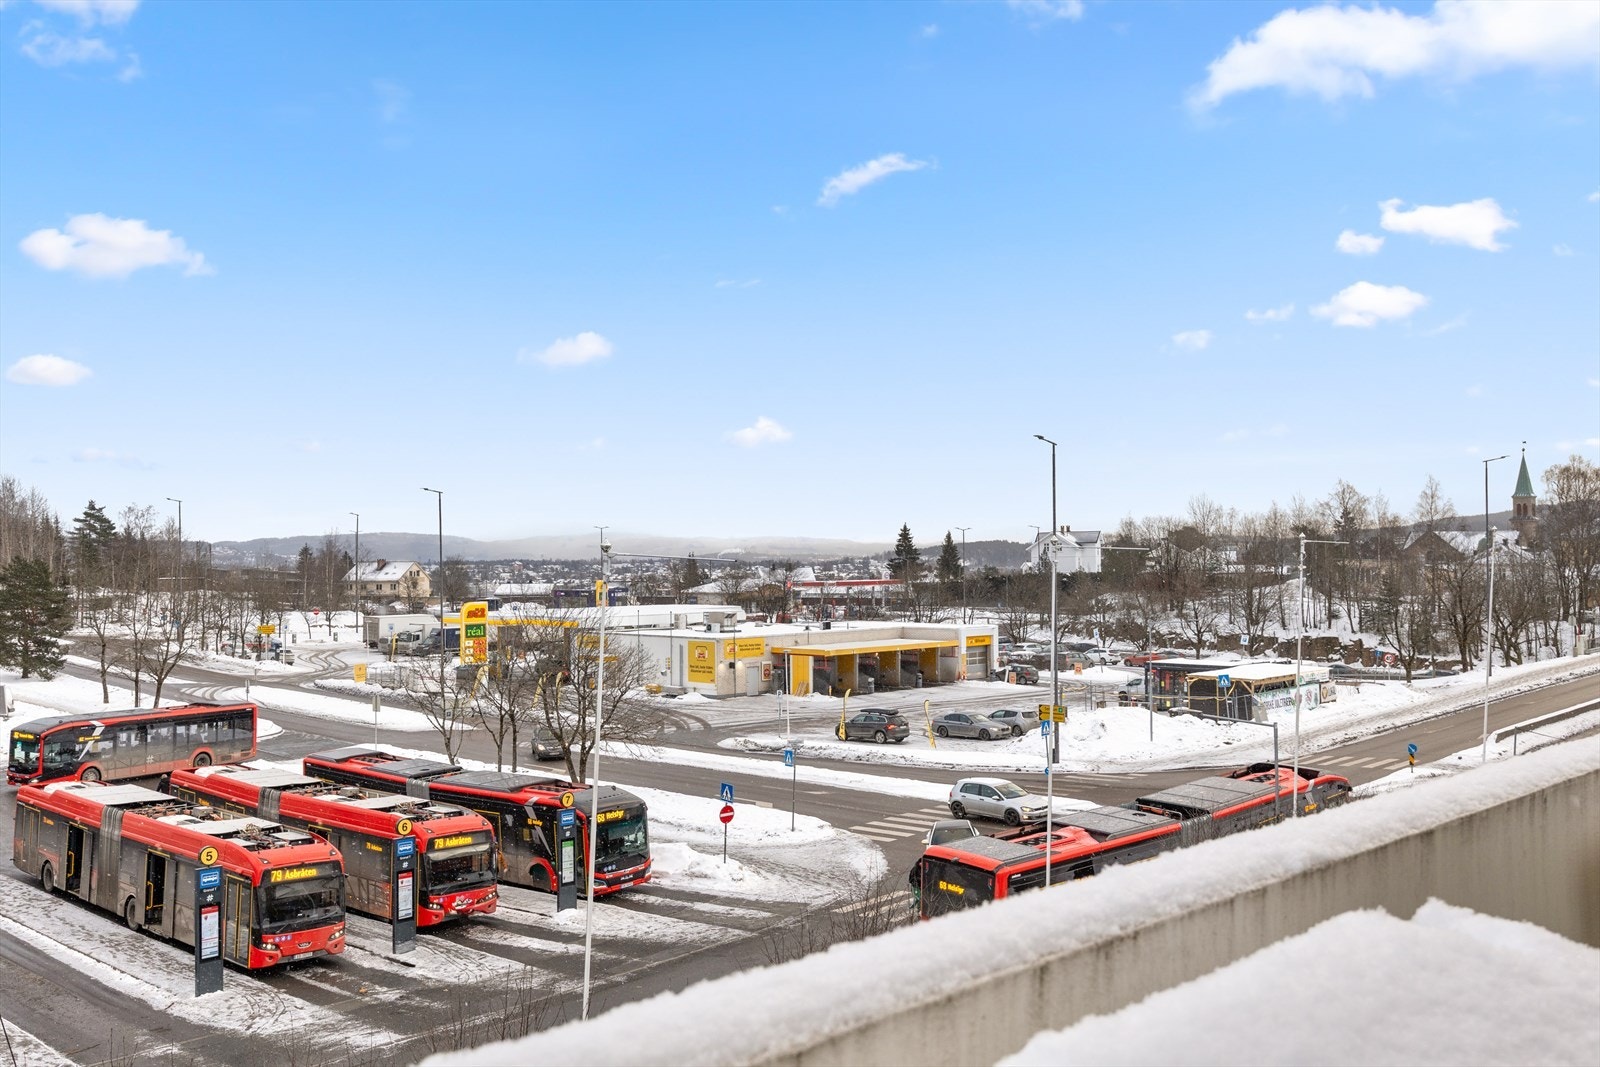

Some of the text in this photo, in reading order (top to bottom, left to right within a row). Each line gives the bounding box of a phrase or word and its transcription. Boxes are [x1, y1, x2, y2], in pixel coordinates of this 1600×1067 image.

[467, 626, 484, 636] réal
[566, 796, 571, 804] 7
[597, 814, 605, 823] 68
[402, 822, 408, 832] 6
[434, 838, 444, 849] 79
[206, 851, 213, 862] 5
[271, 870, 282, 883] 79
